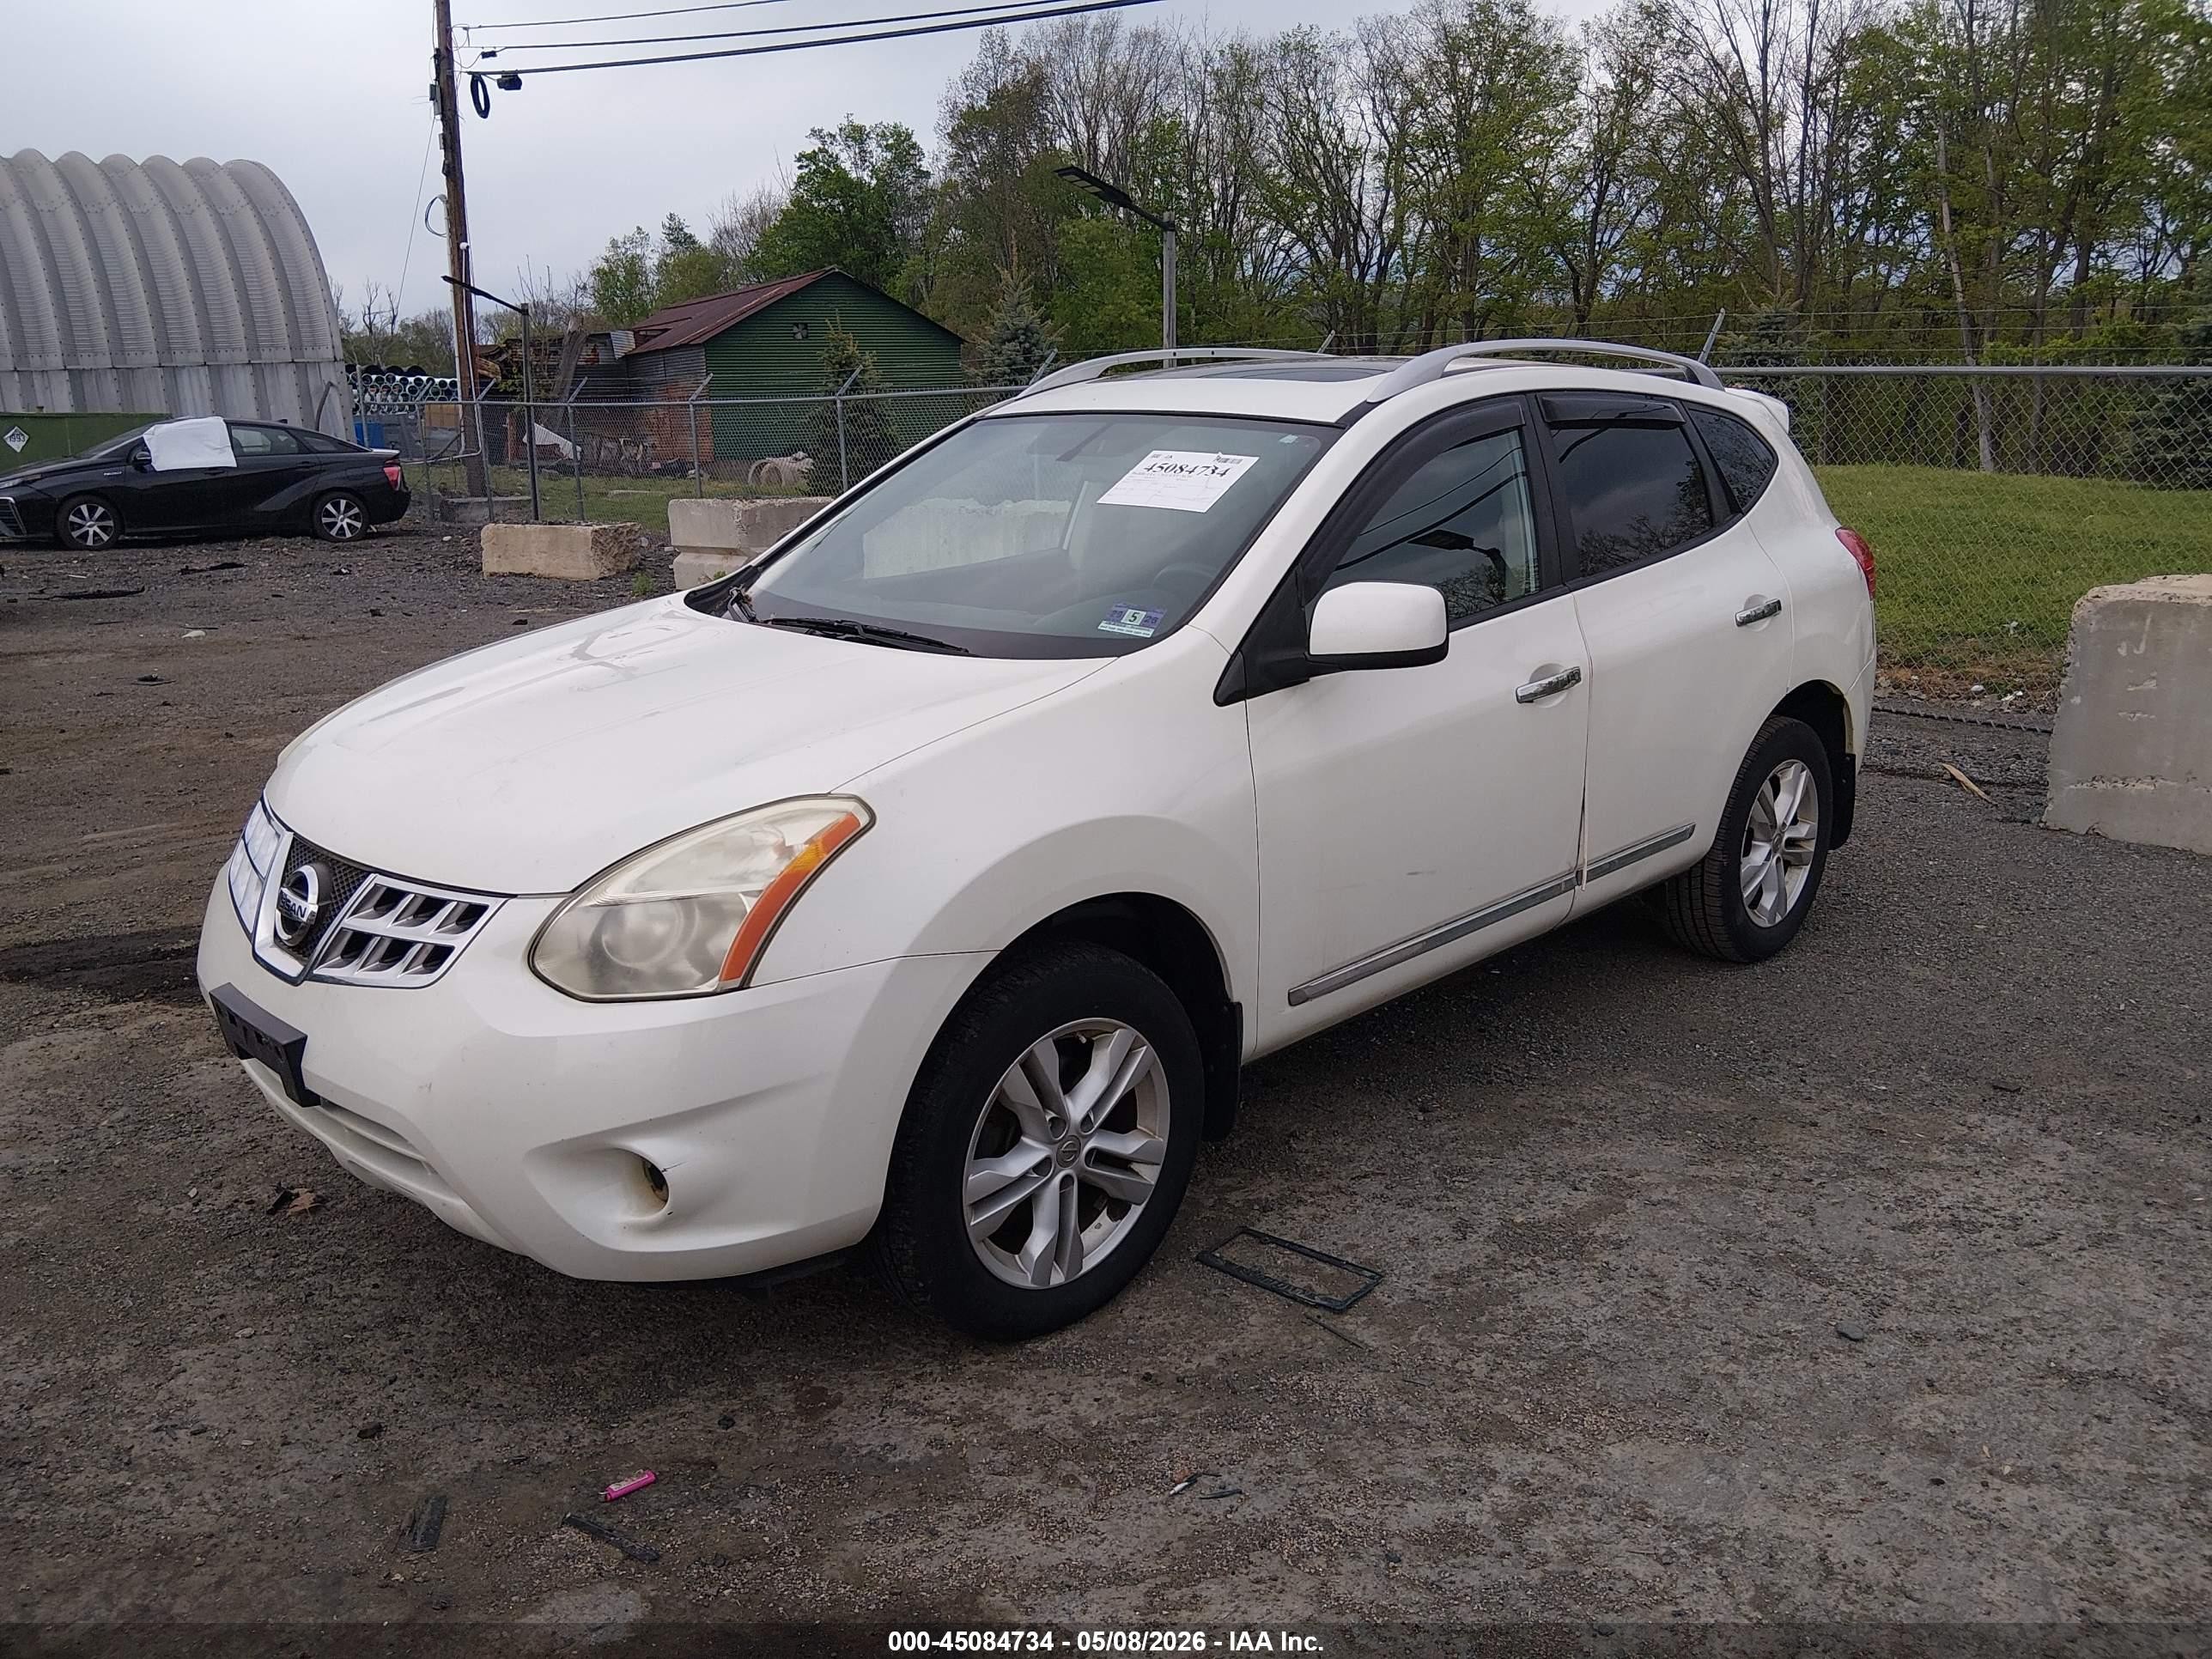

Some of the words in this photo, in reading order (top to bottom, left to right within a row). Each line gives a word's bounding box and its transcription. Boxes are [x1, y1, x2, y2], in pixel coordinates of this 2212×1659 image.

[9, 434, 25, 442] 1993
[1144, 462, 1231, 477] 45084734
[1128, 611, 1140, 623] 5
